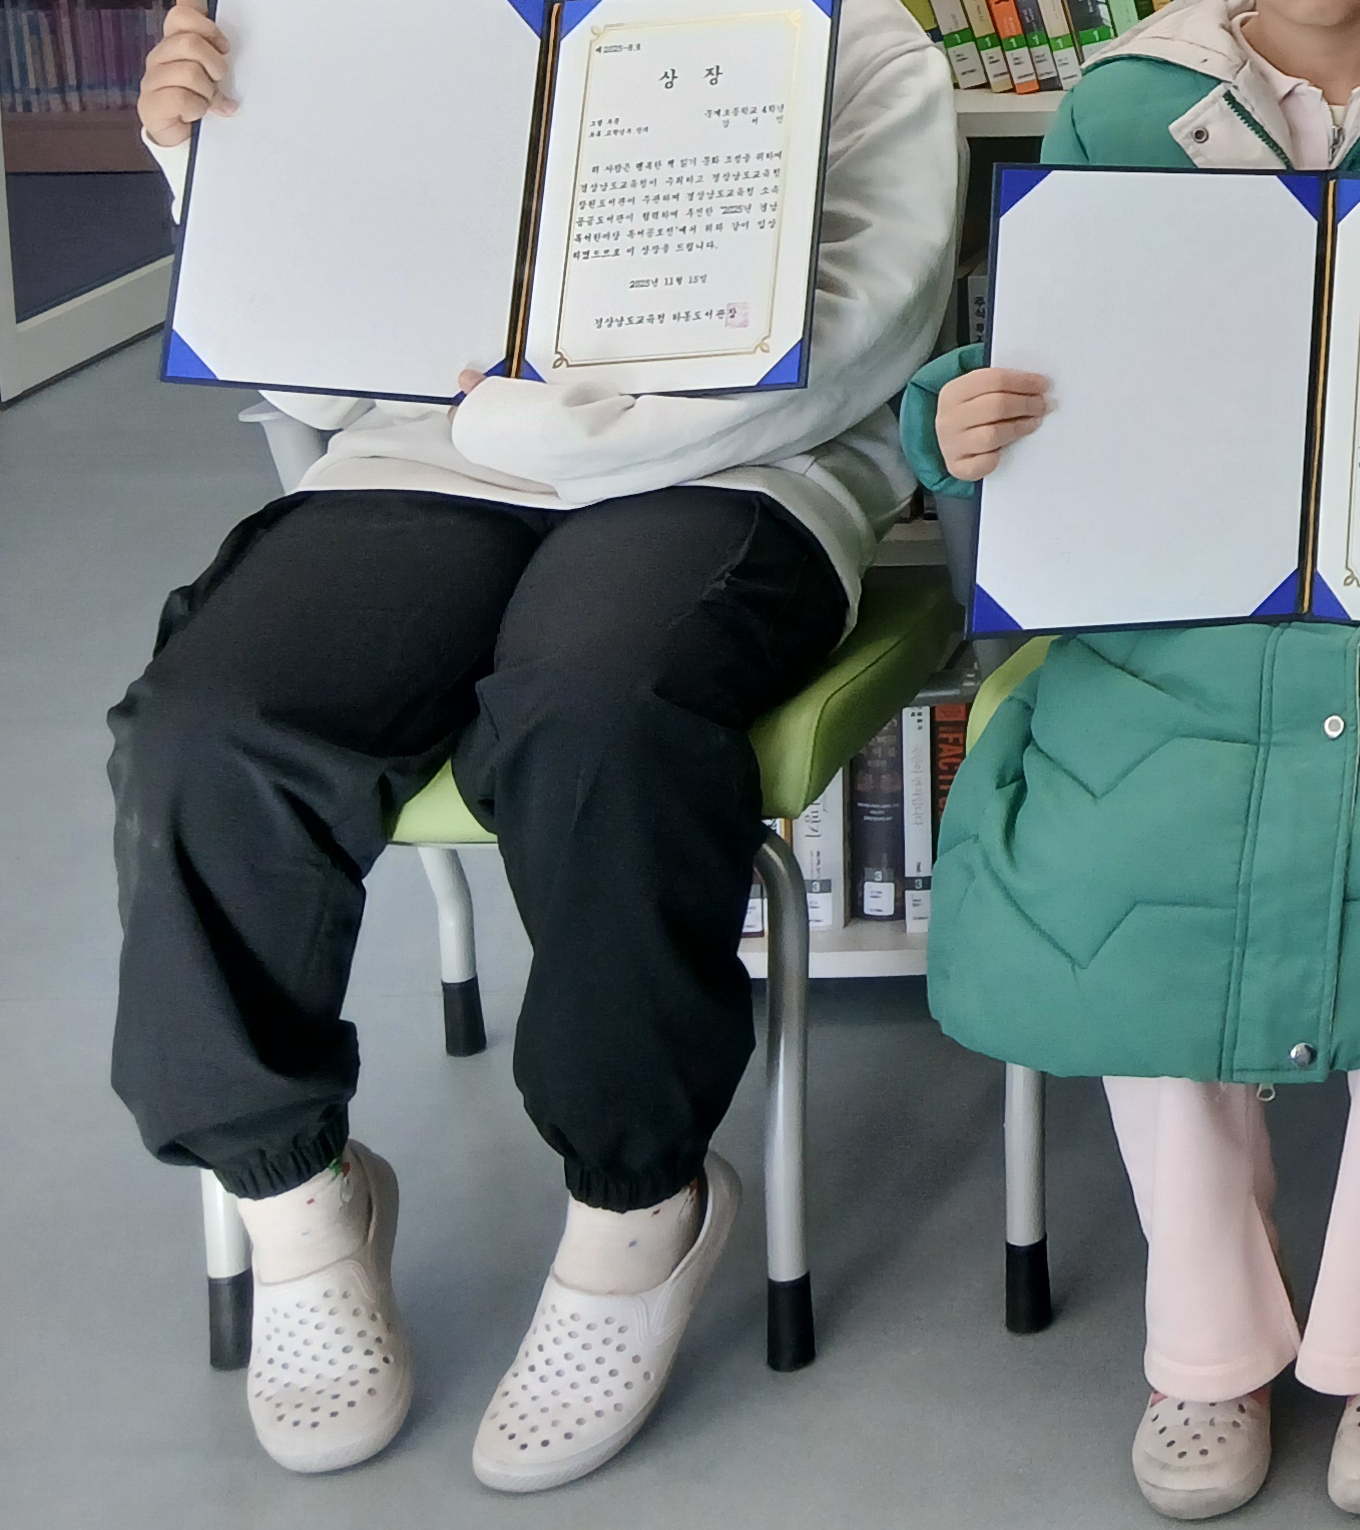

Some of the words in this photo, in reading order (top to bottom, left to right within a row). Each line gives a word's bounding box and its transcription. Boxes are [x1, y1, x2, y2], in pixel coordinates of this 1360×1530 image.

[659, 69, 678, 89] 상
[703, 65, 723, 85] 장
[594, 313, 666, 330] 경상남도교육청
